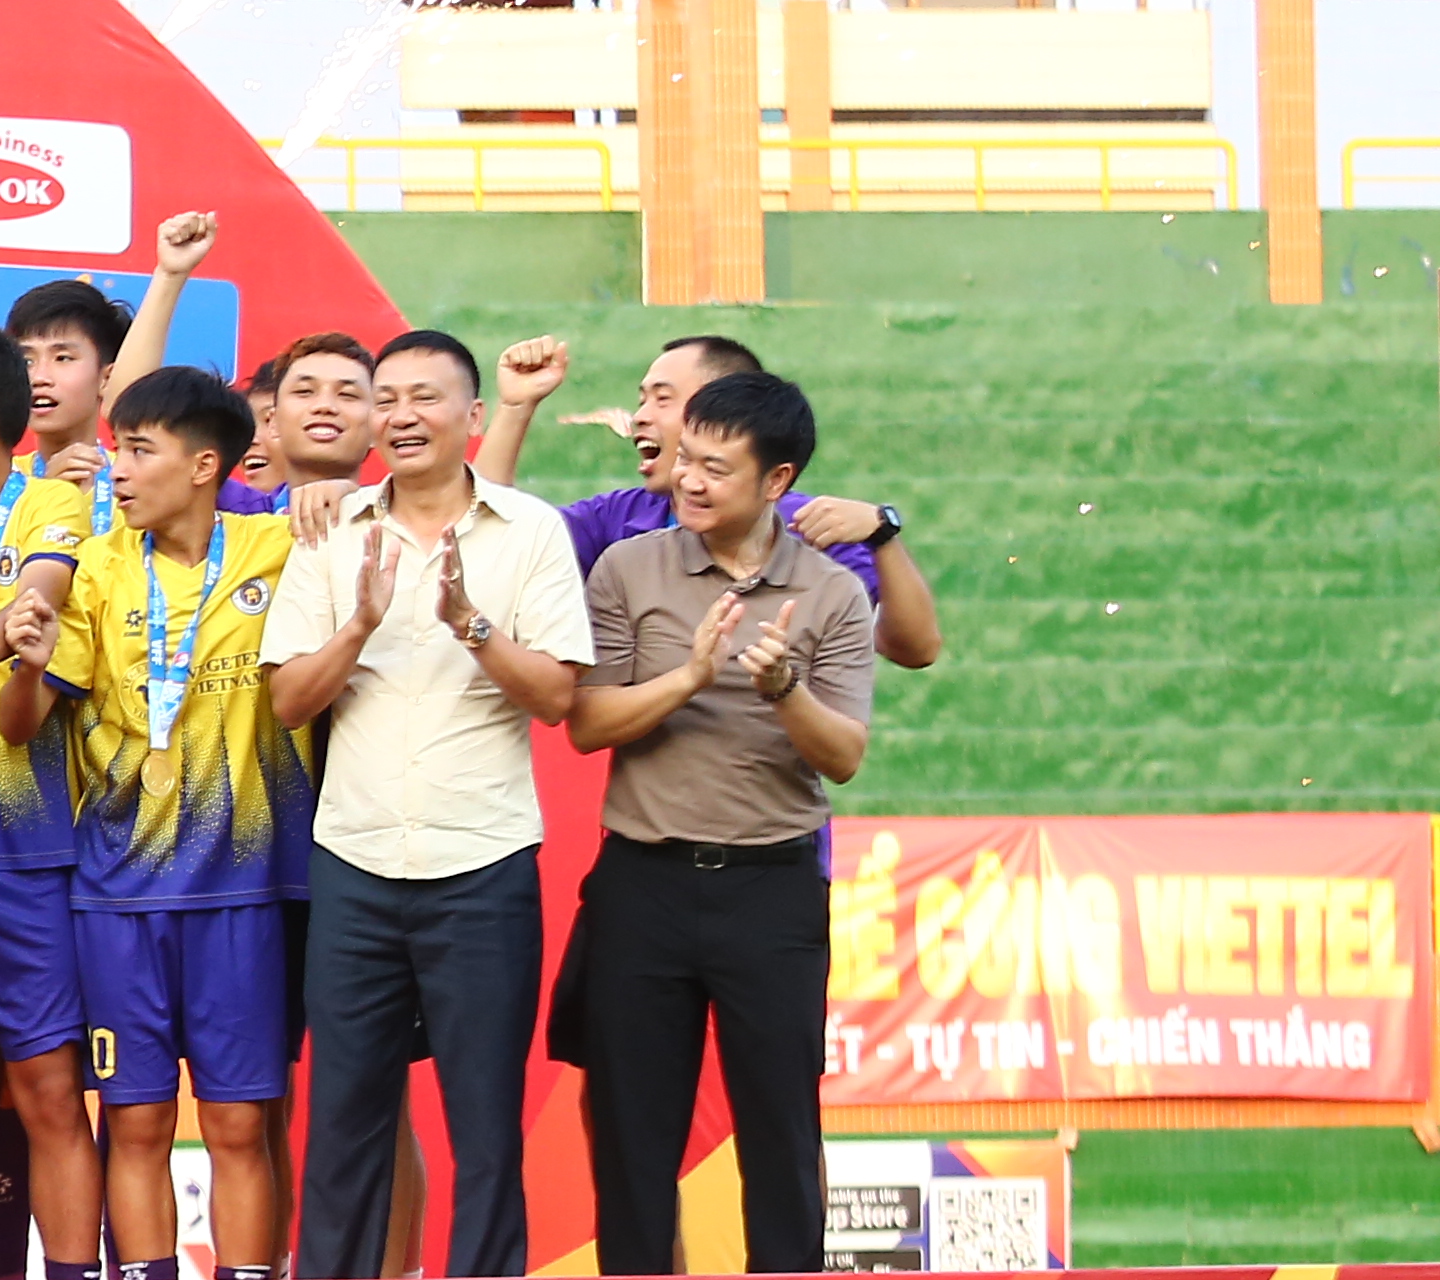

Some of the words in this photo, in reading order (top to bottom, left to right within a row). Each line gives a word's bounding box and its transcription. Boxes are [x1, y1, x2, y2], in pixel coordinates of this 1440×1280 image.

[150, 639, 163, 666] VFF
[915, 849, 1121, 1001] CÔNG
[1134, 874, 1414, 1000] VIETTEL
[906, 1017, 965, 1081] TỰ
[971, 1020, 1045, 1070] TIN
[1087, 1004, 1221, 1068] CHIẾN
[1230, 1007, 1372, 1070] THẮNG
